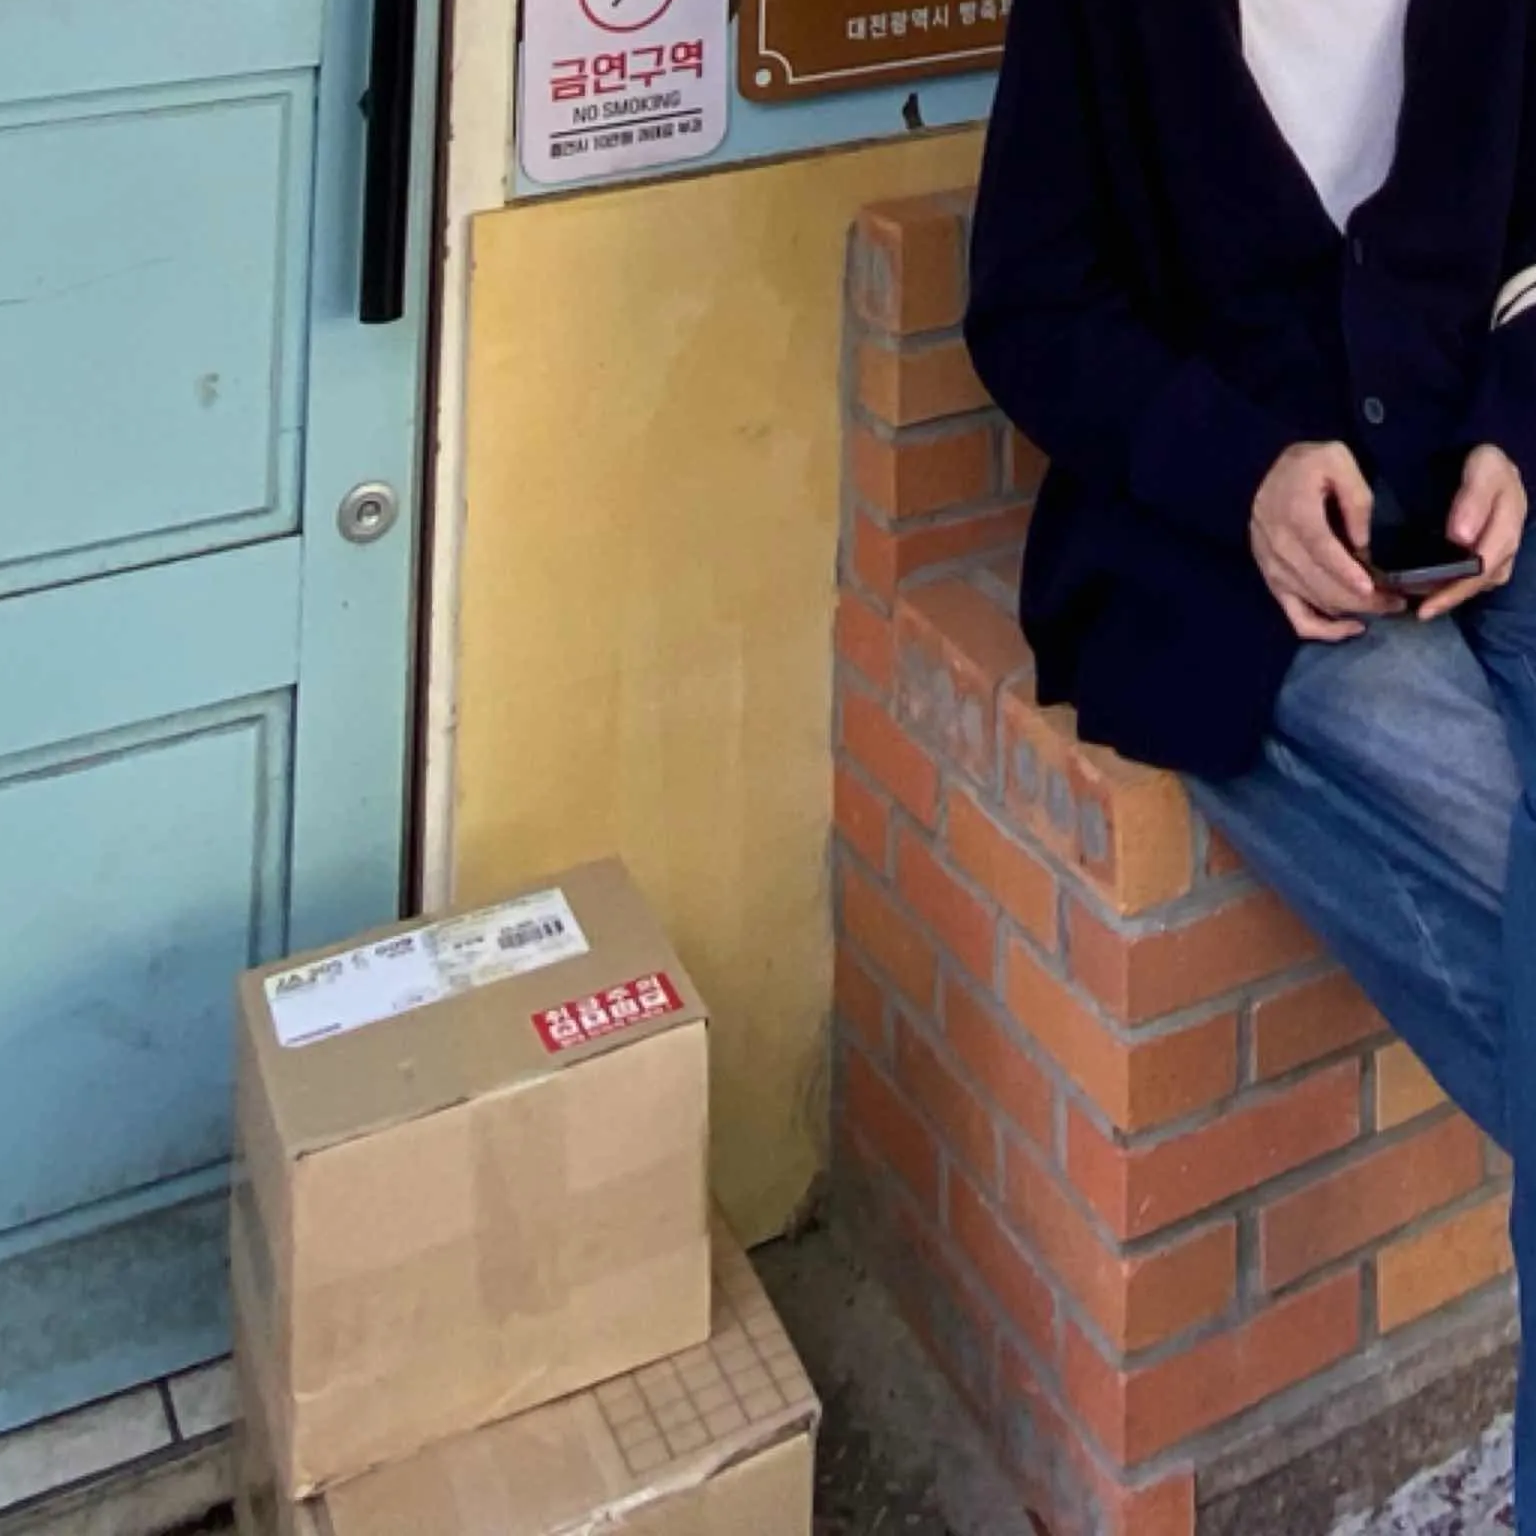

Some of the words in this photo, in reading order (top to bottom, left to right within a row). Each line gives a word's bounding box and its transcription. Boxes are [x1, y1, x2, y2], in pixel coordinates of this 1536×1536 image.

[847, 3, 950, 41] 대전광역시
[550, 38, 705, 103] 금연구역
[572, 103, 599, 124] NO
[602, 90, 682, 119] SMOKING
